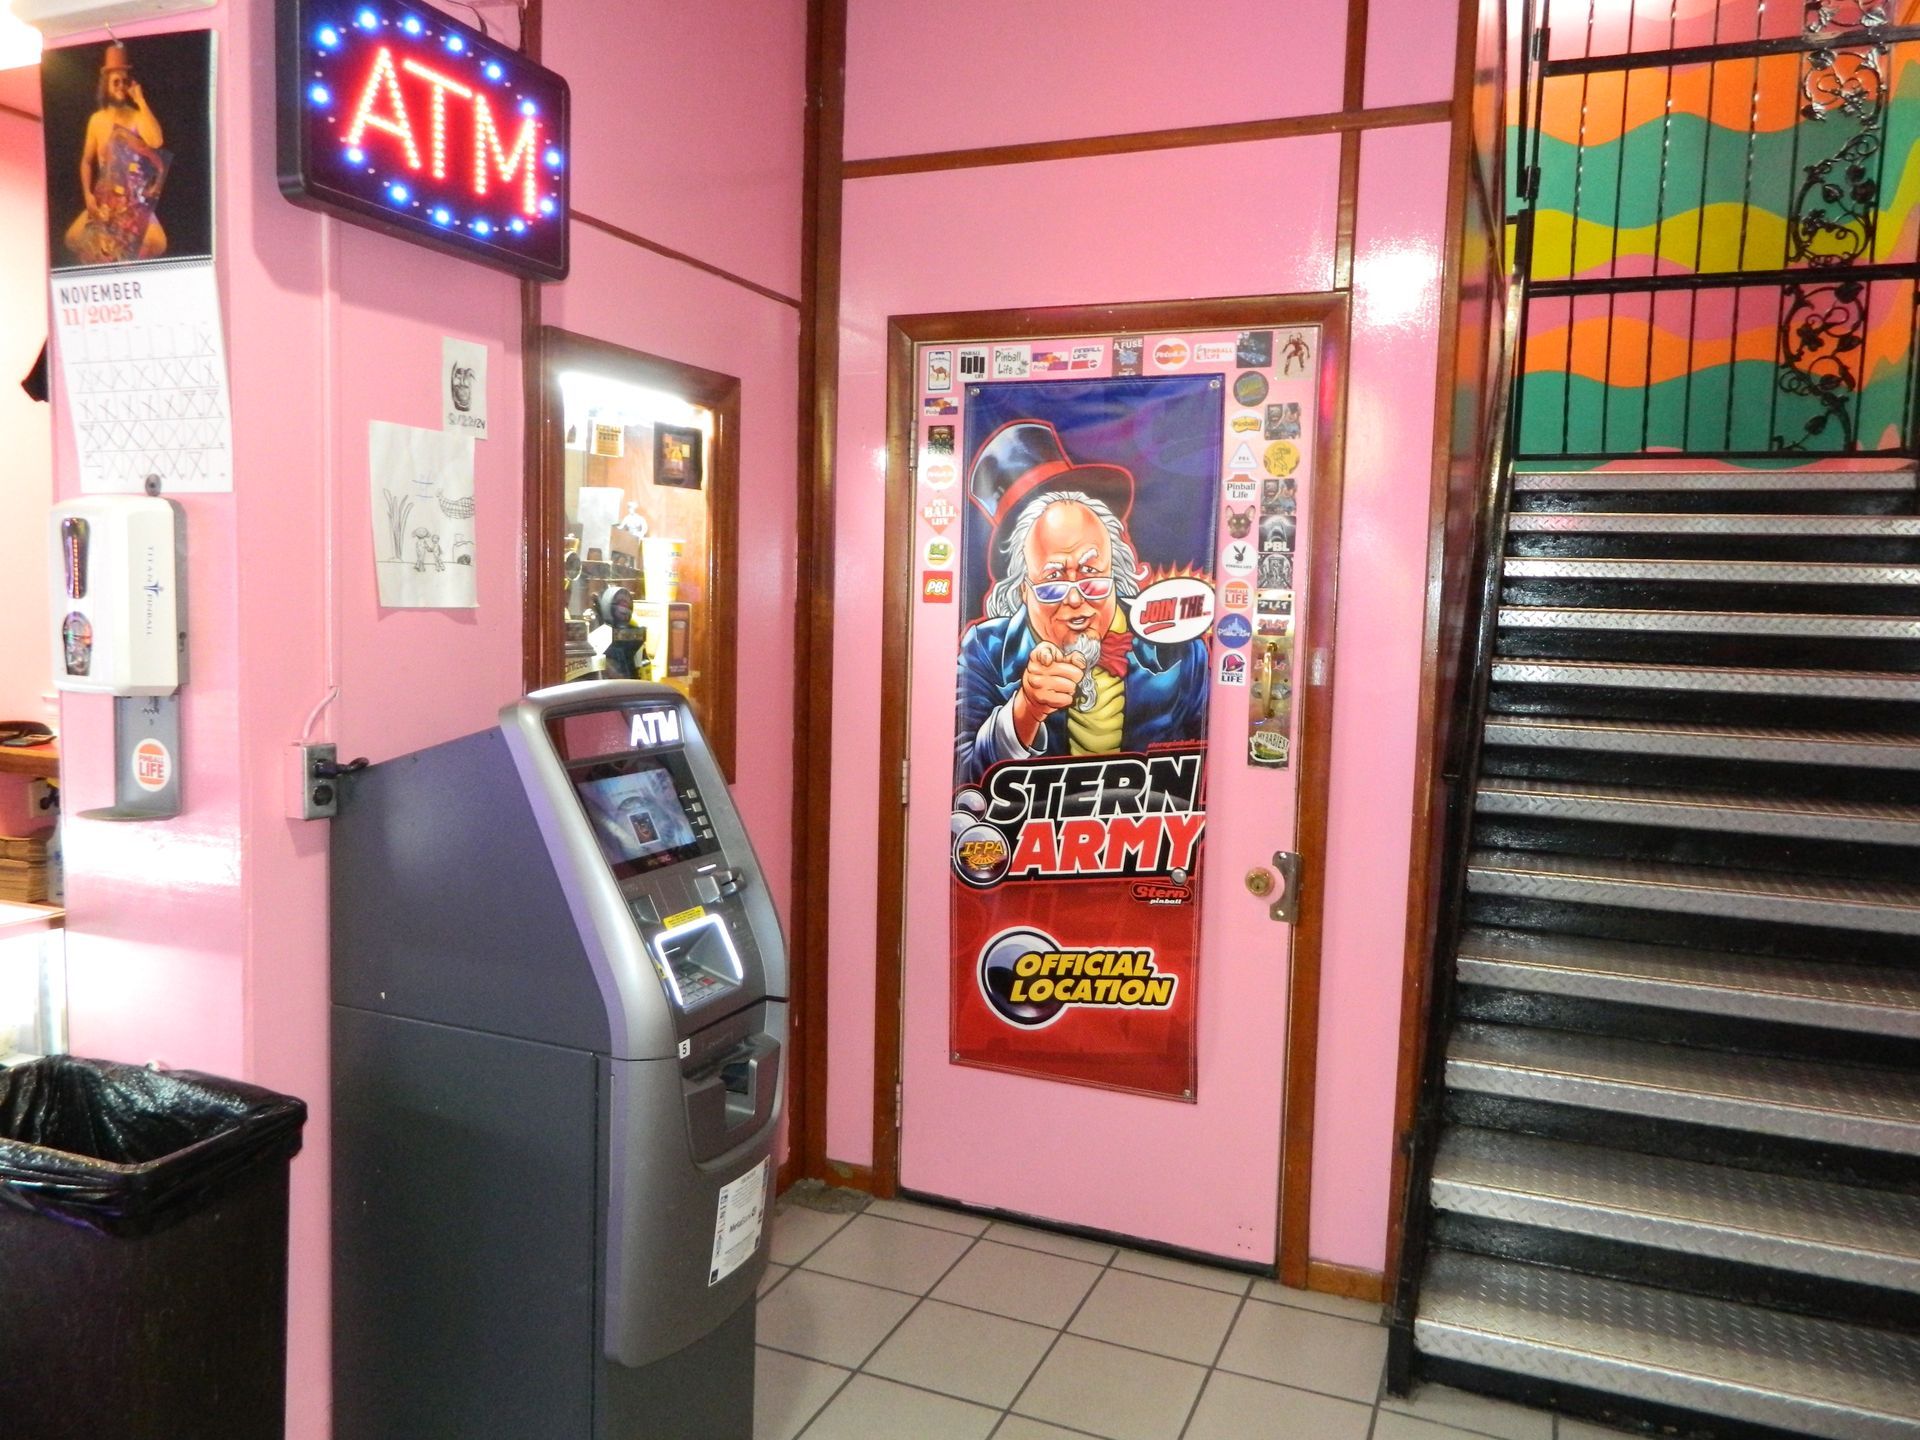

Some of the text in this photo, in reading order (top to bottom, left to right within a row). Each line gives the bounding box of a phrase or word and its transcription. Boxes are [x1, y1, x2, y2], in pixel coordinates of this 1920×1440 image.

[344, 45, 540, 217] ATM
[60, 281, 143, 304] NOVEMBER
[62, 304, 134, 327] 11/2025
[1121, 338, 1143, 349] FUSE
[995, 350, 1022, 363] Pinball
[998, 363, 1013, 374] Life
[1226, 483, 1256, 491] Pinball
[1232, 490, 1249, 498] Life
[1263, 542, 1290, 551] PBL
[926, 581, 949, 594] PBL
[1225, 593, 1249, 604] LIFE
[1139, 596, 1178, 625] JOIN
[1221, 675, 1243, 683] LIFE
[629, 708, 680, 748] ATM
[138, 754, 165, 765] PINBALL
[138, 763, 165, 779] LIFE
[985, 755, 1207, 824] STERN
[960, 840, 1005, 857] IFPA
[1008, 814, 1208, 876] ARMY
[1136, 885, 1185, 898] Stern
[1149, 897, 1182, 905] pinball
[1014, 950, 1153, 978] OFFICIAL
[1009, 976, 1173, 1005] LOCATION
[682, 1042, 688, 1055] 5
